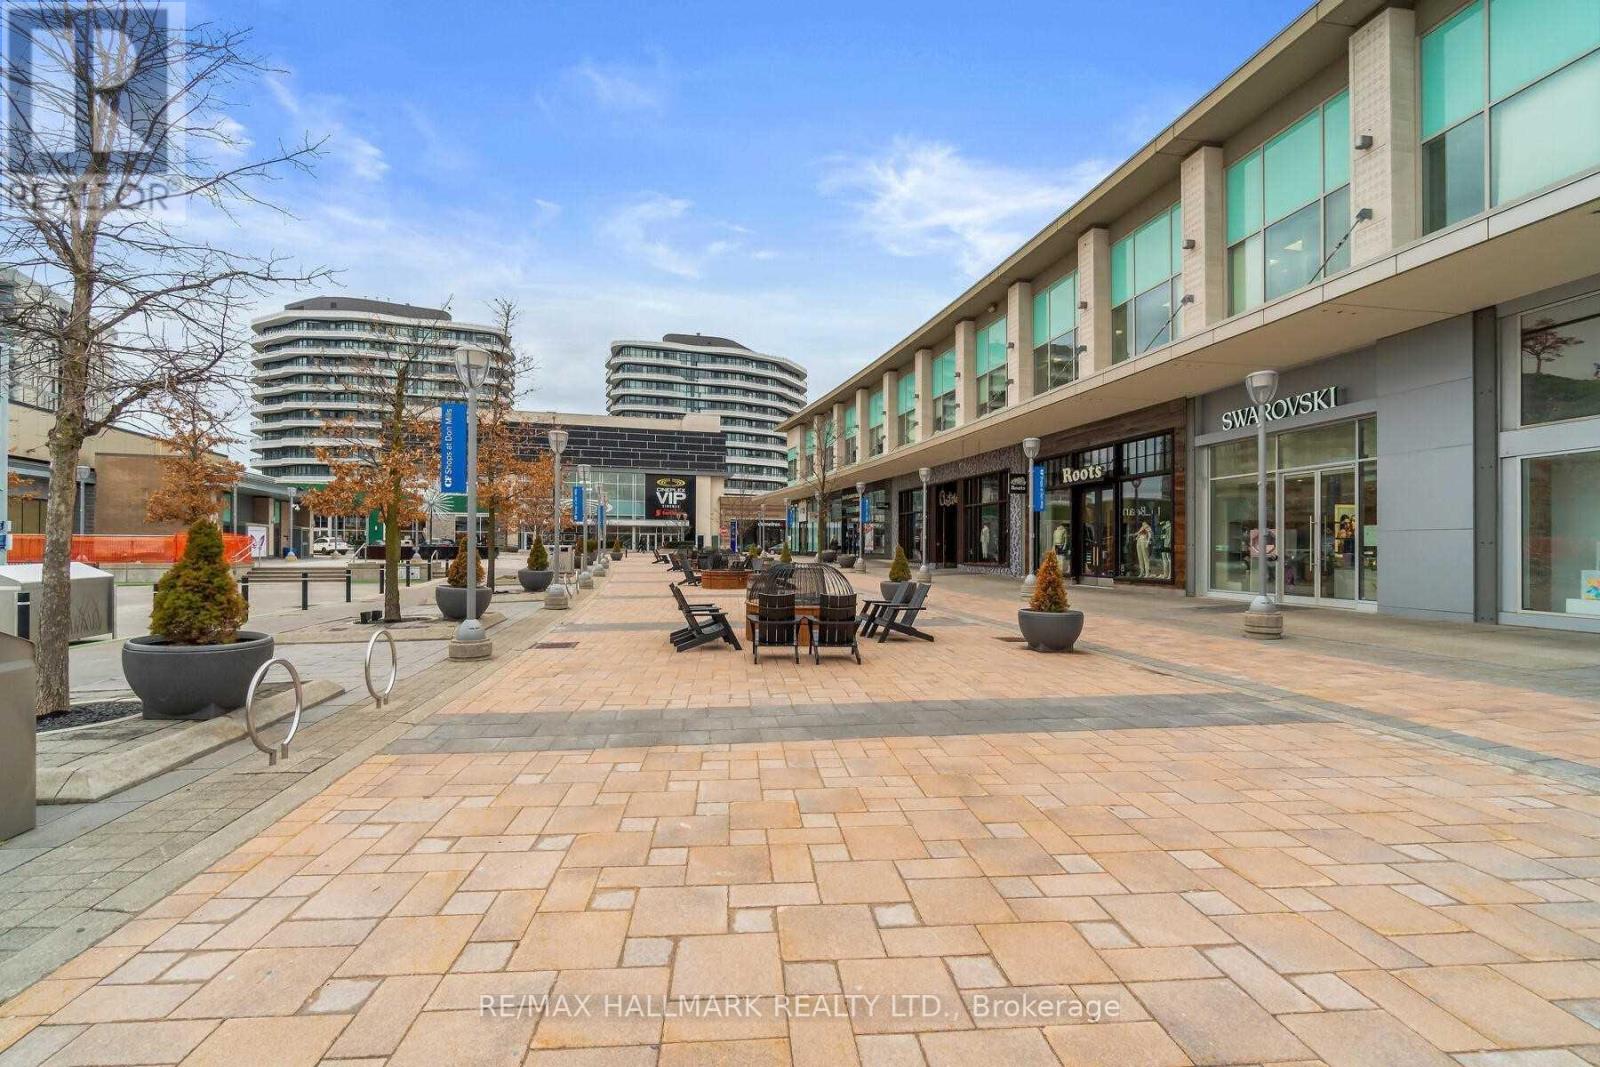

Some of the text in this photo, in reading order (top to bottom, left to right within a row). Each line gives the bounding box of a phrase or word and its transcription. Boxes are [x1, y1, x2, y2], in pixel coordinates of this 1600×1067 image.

[1221, 386, 1340, 431] SWAROVSKI
[444, 426, 453, 442] Don
[445, 443, 453, 451] at
[444, 452, 453, 475] Shops
[1062, 465, 1102, 483] Roots
[655, 491, 687, 504] VIP
